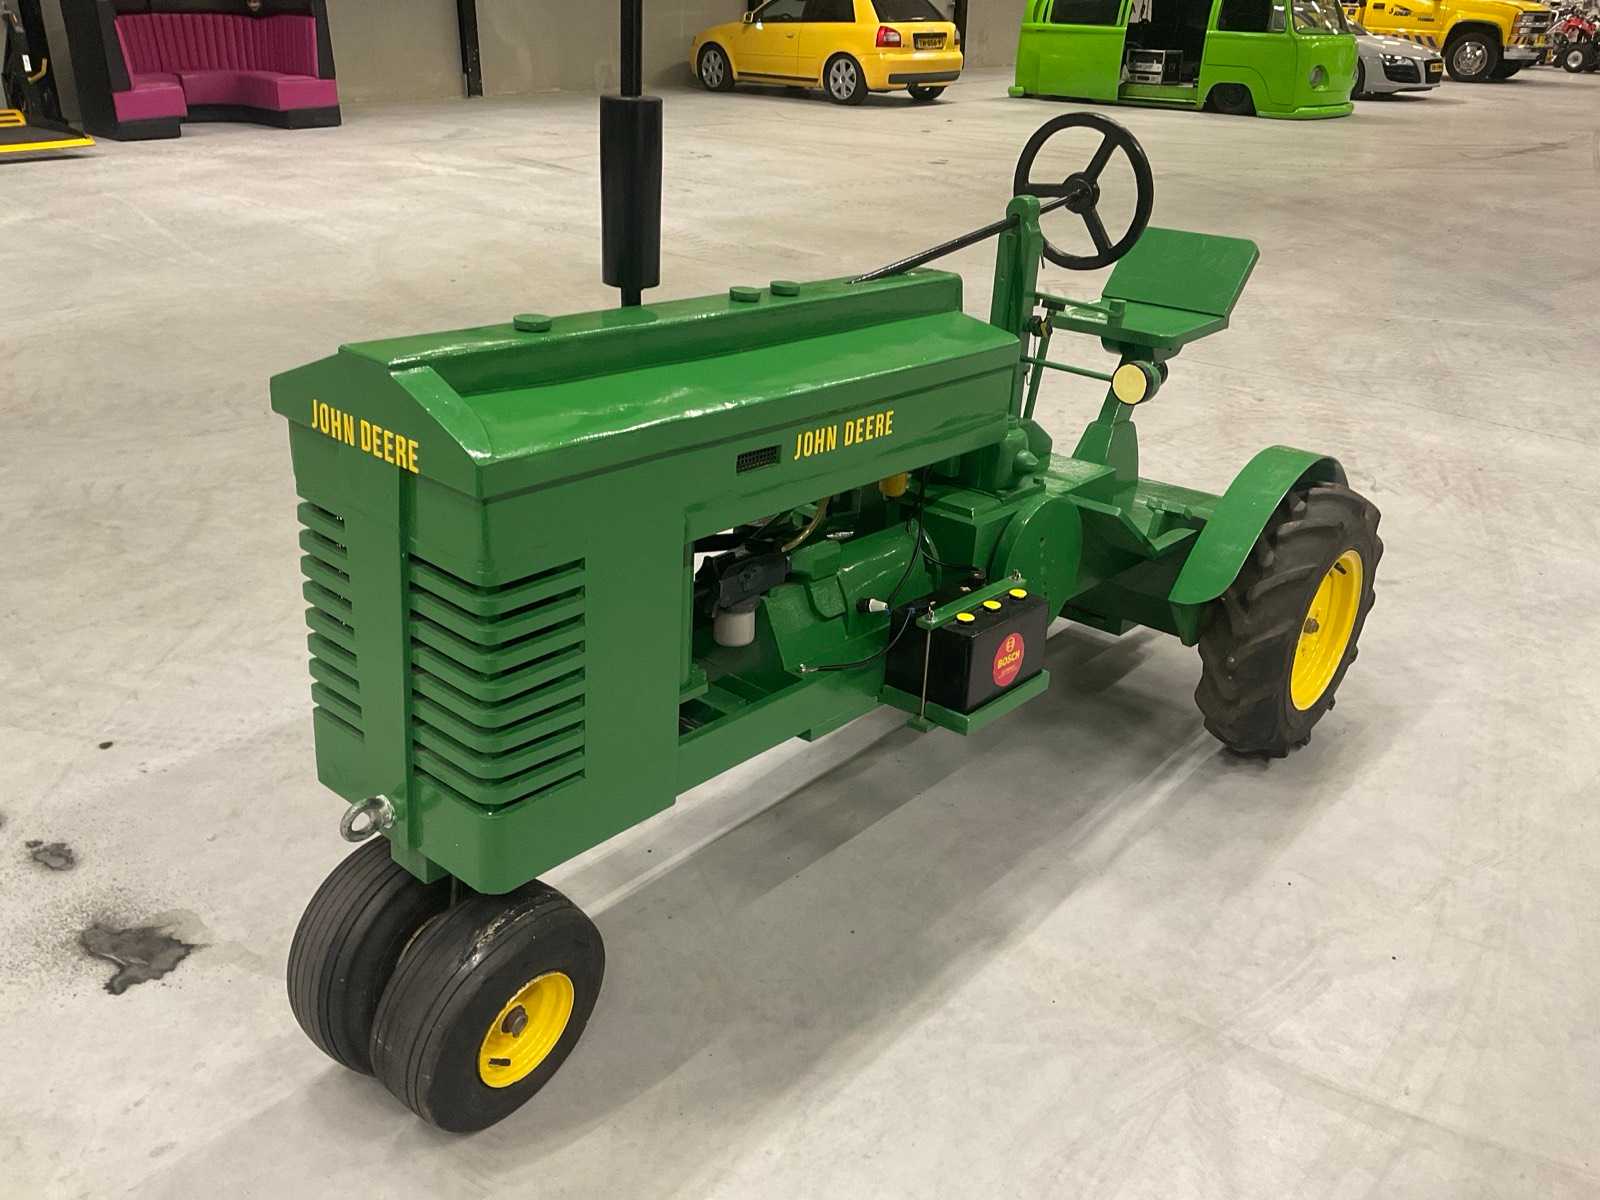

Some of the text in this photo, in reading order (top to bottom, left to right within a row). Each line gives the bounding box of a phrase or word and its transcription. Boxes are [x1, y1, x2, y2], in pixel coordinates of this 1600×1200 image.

[311, 399, 419, 474] JOHN DEERE
[794, 410, 894, 460] JOHN DEERE
[997, 649, 1020, 669] BOSCH
